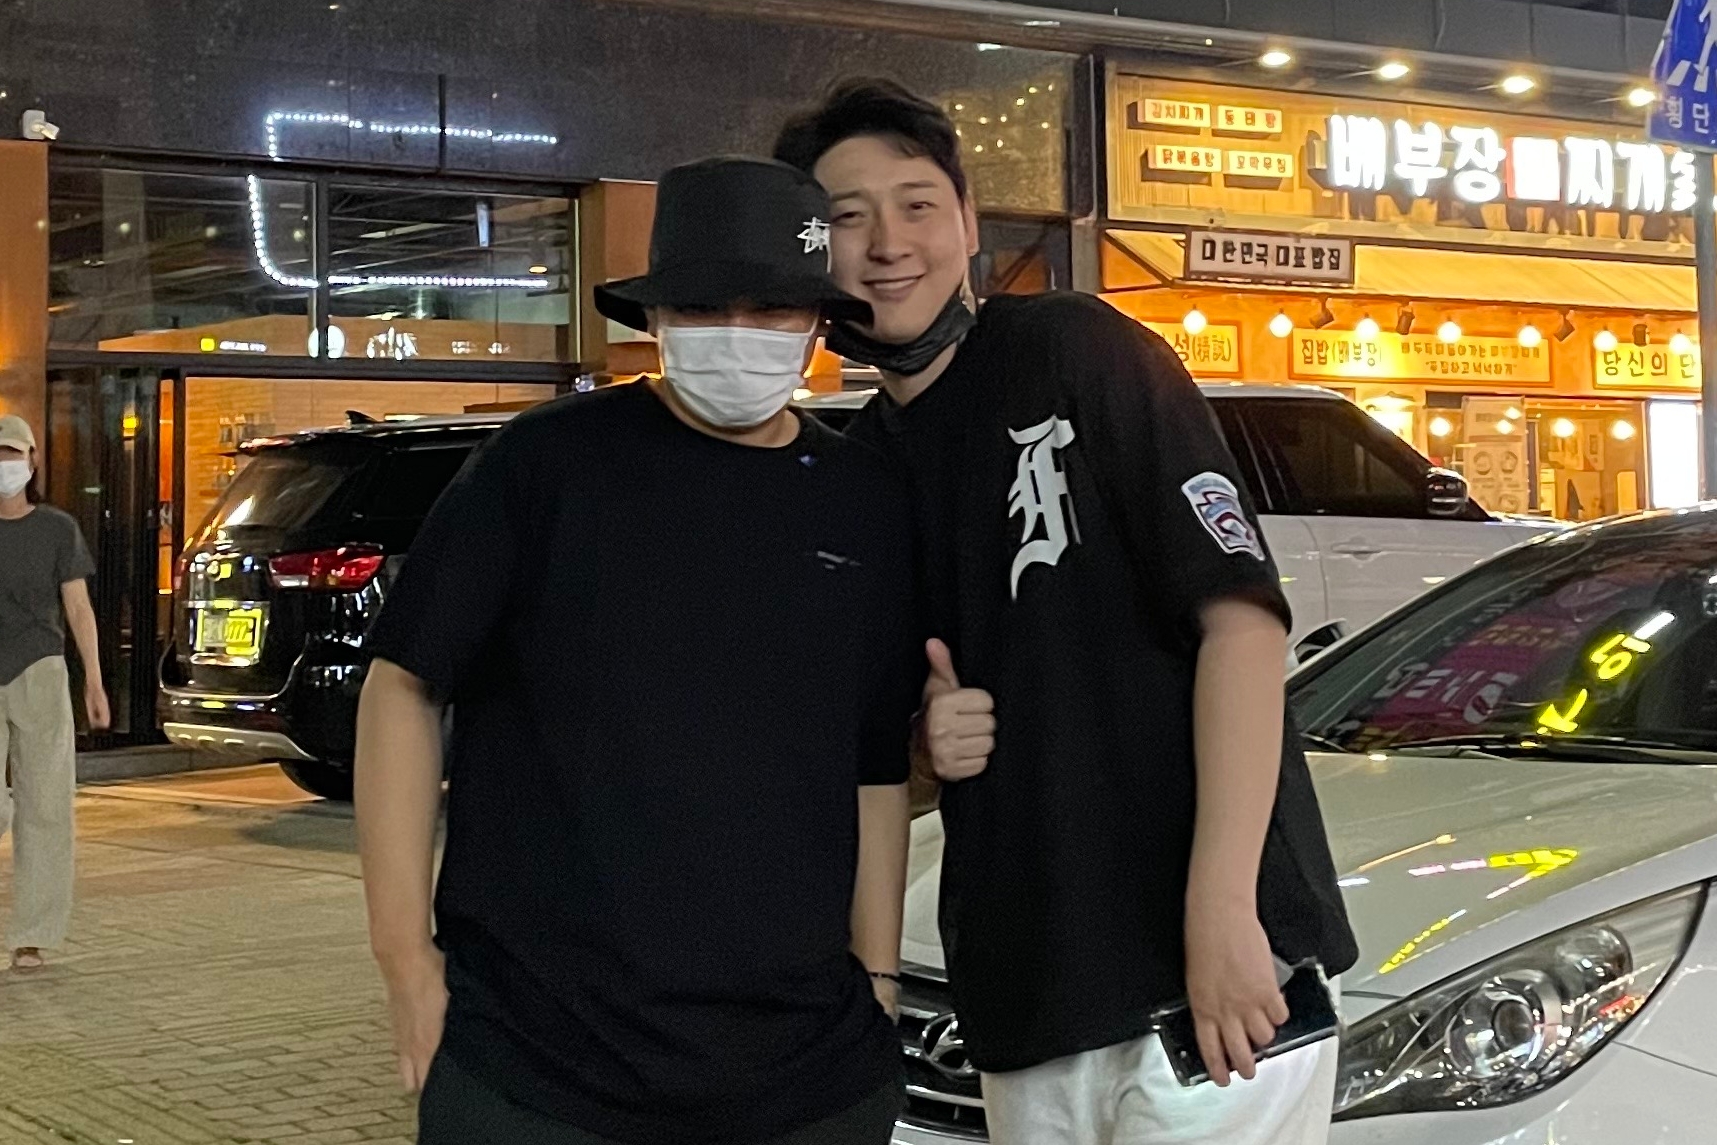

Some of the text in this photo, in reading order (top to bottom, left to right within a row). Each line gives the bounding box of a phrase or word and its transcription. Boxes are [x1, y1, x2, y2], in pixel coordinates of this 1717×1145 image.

[1151, 101, 1204, 121] 김치찌개
[1329, 113, 1506, 203] 배부장
[1603, 349, 1668, 378] 당신의
